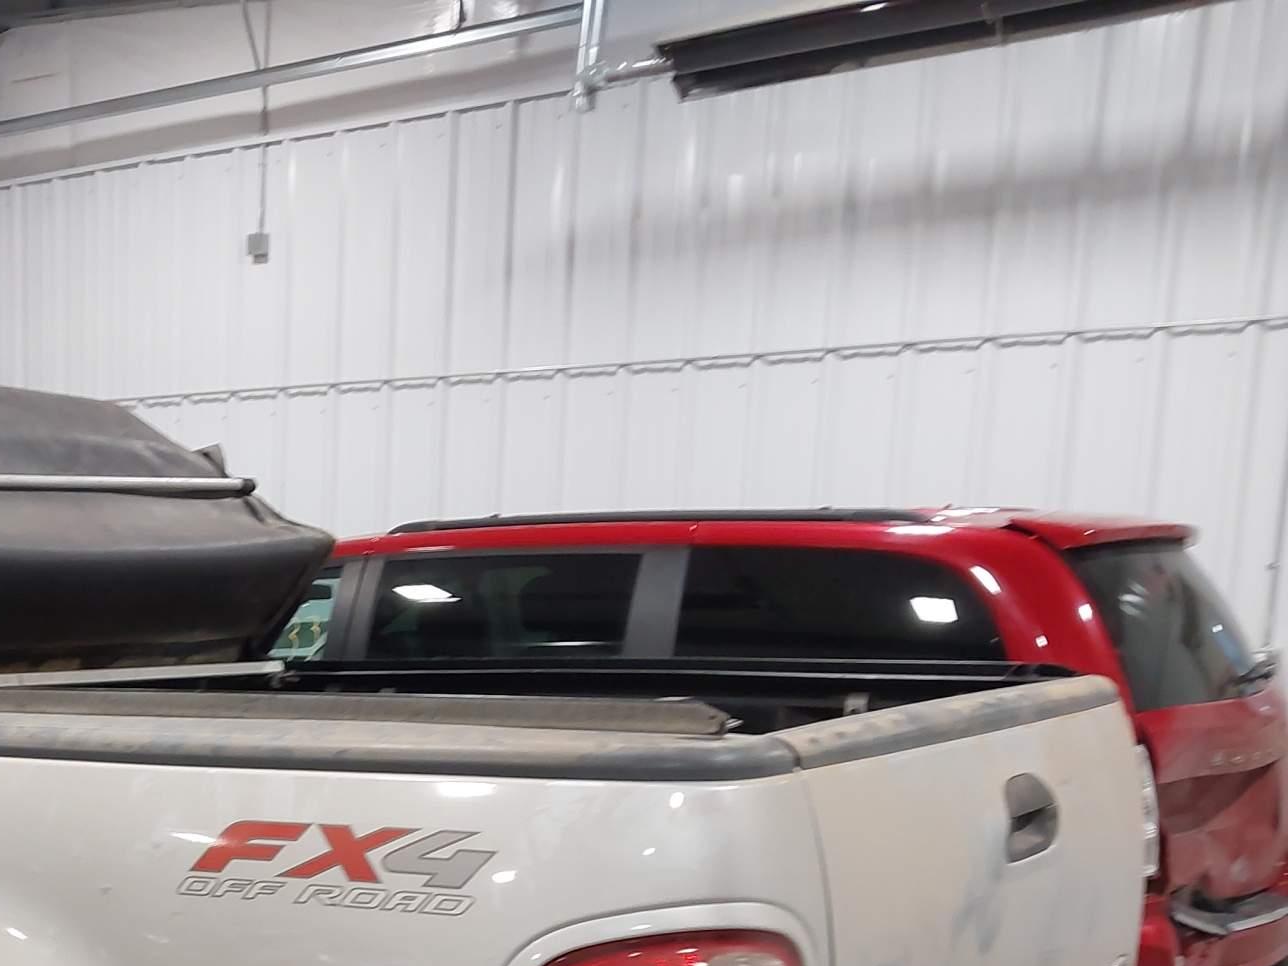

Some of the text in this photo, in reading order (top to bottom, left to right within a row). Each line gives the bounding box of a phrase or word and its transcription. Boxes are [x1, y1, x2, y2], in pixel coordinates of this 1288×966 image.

[188, 820, 500, 890] FX4
[176, 875, 477, 917] OFF ROAD
